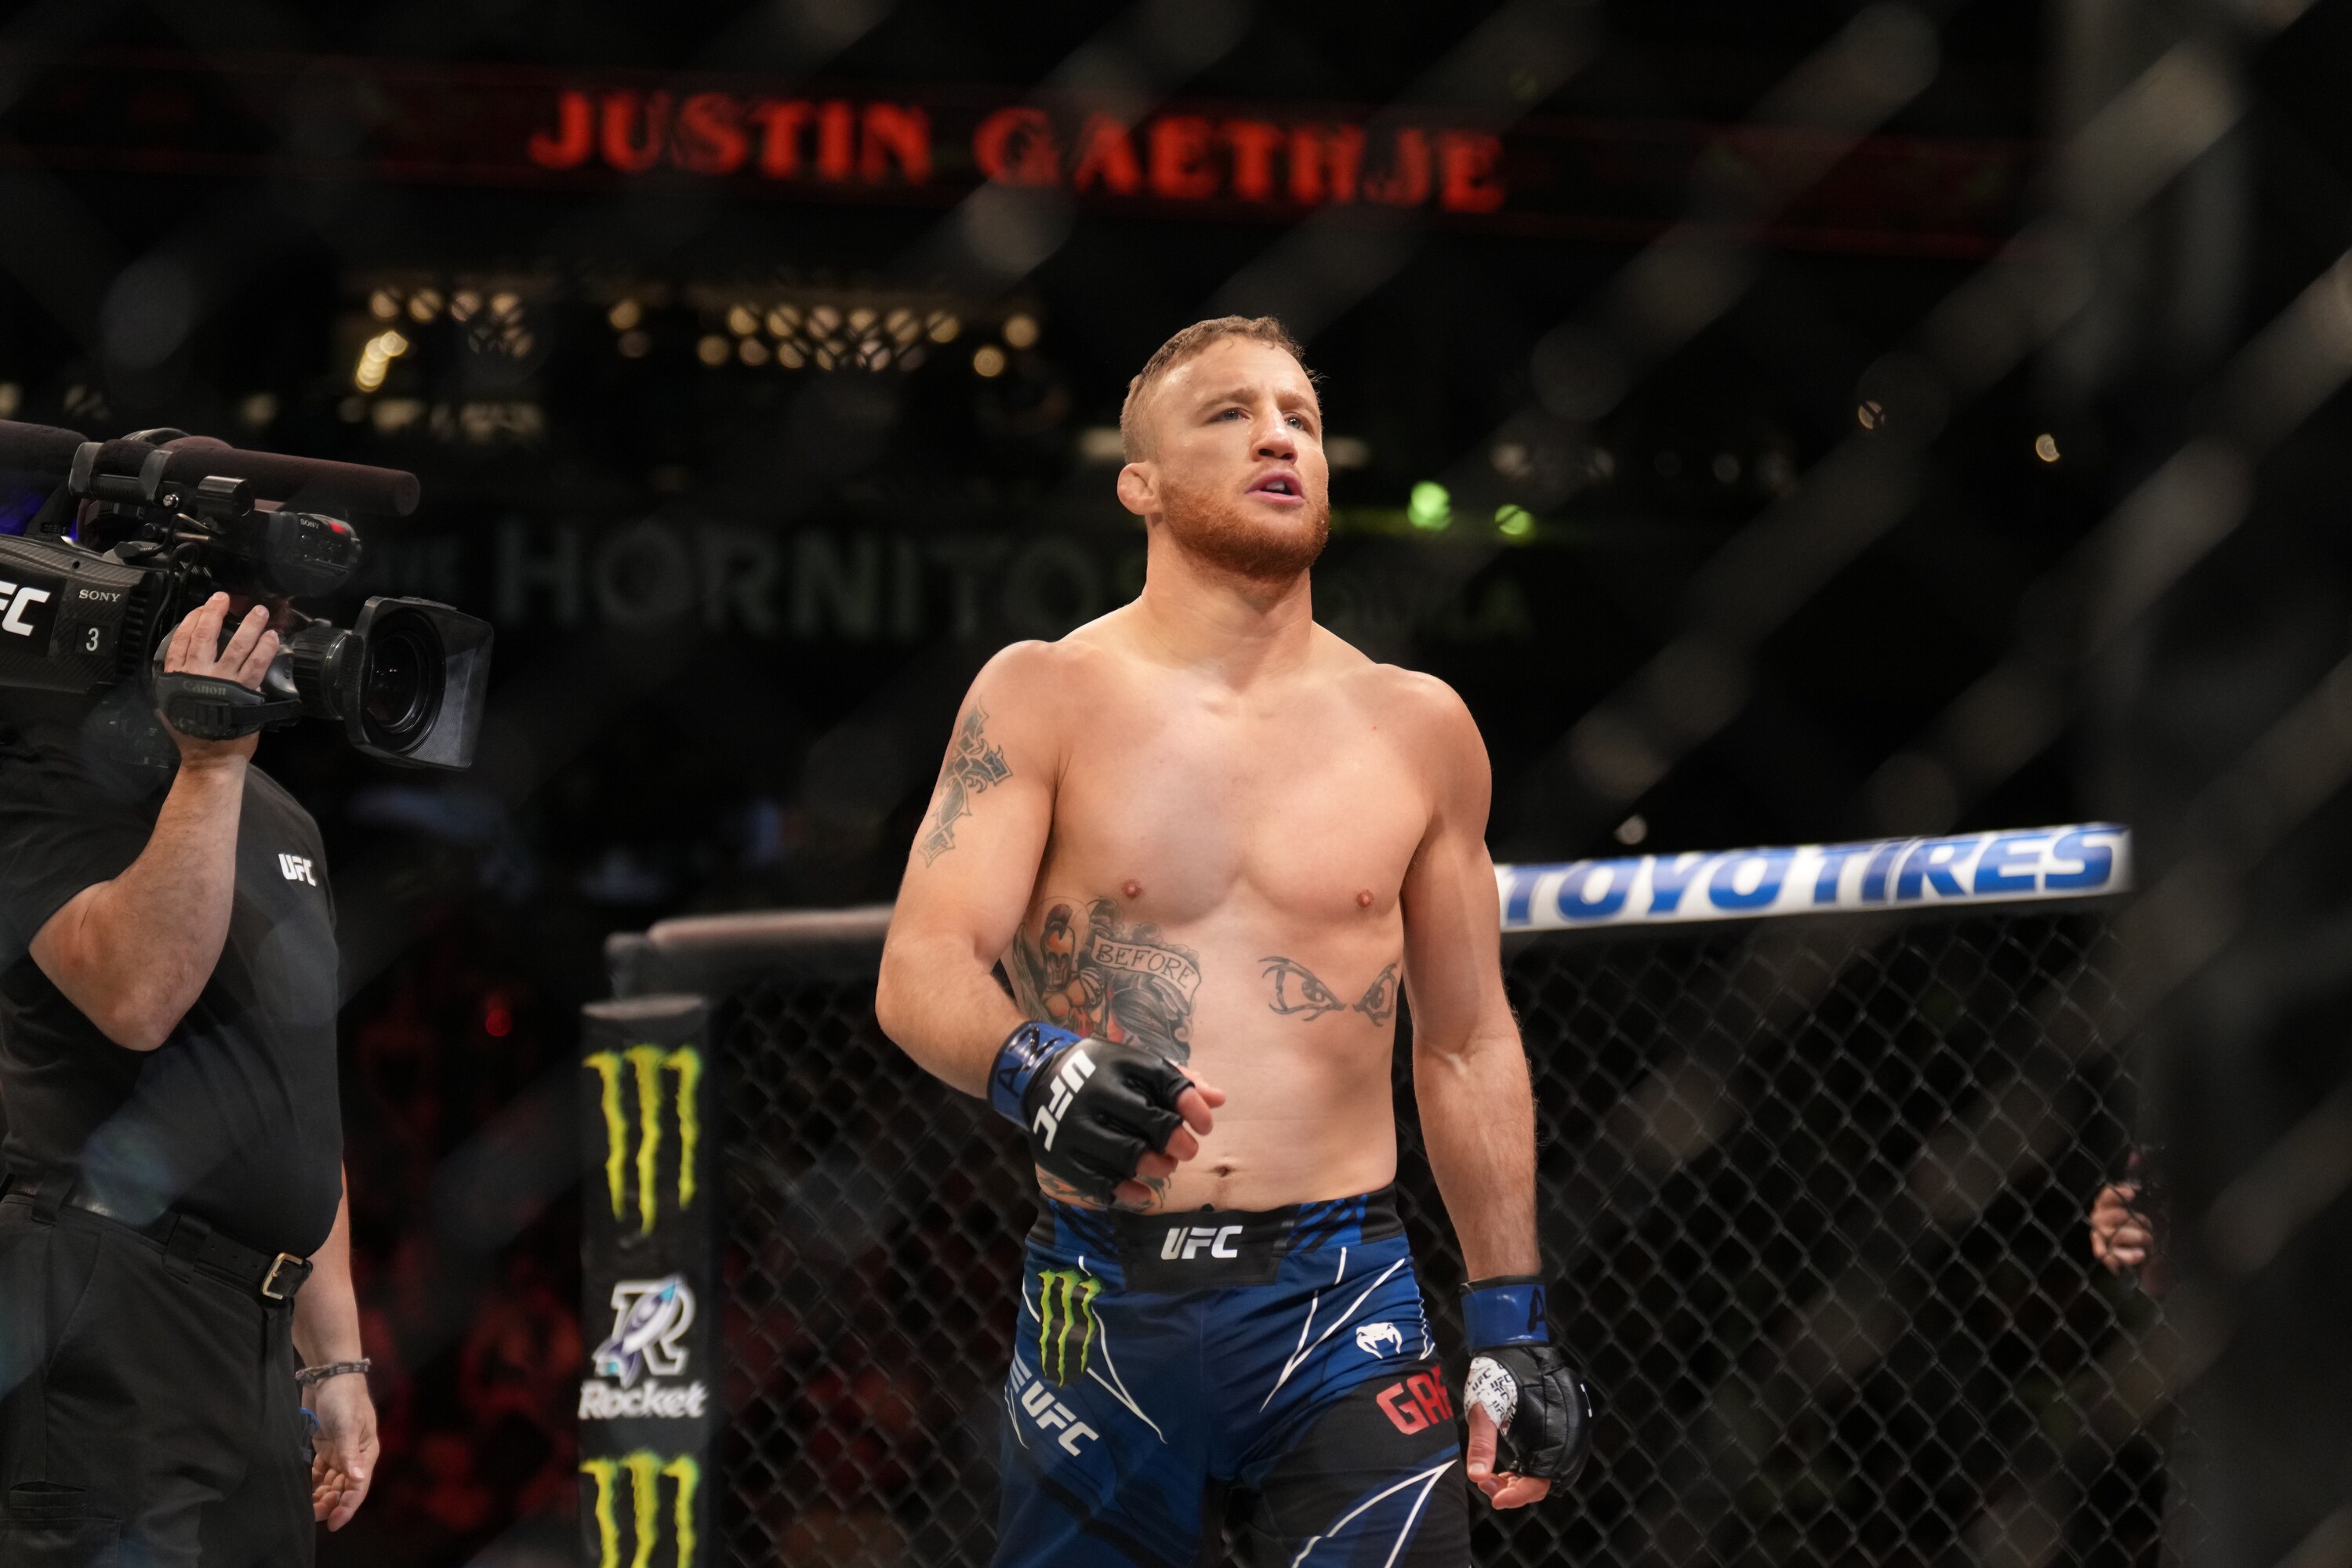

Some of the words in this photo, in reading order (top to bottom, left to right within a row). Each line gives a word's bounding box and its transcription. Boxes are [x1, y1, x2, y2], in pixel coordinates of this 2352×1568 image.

[528, 89, 933, 185] JUSTIN
[972, 107, 1502, 212] GAETHJE
[299, 518, 319, 529] SONY
[79, 589, 121, 603] SONY
[85, 627, 99, 652] 3
[183, 681, 227, 696] Canon
[278, 853, 316, 887] UFC
[1505, 847, 1798, 927] TOYO
[1813, 824, 2127, 904] TIRES
[1095, 944, 1196, 989] BEFORE
[1033, 1049, 1096, 1152] UFC
[1160, 1225, 1243, 1261] UFC
[1472, 1367, 1491, 1392] UFC
[577, 1379, 709, 1420] Rocket
[1021, 1380, 1099, 1457] UFC
